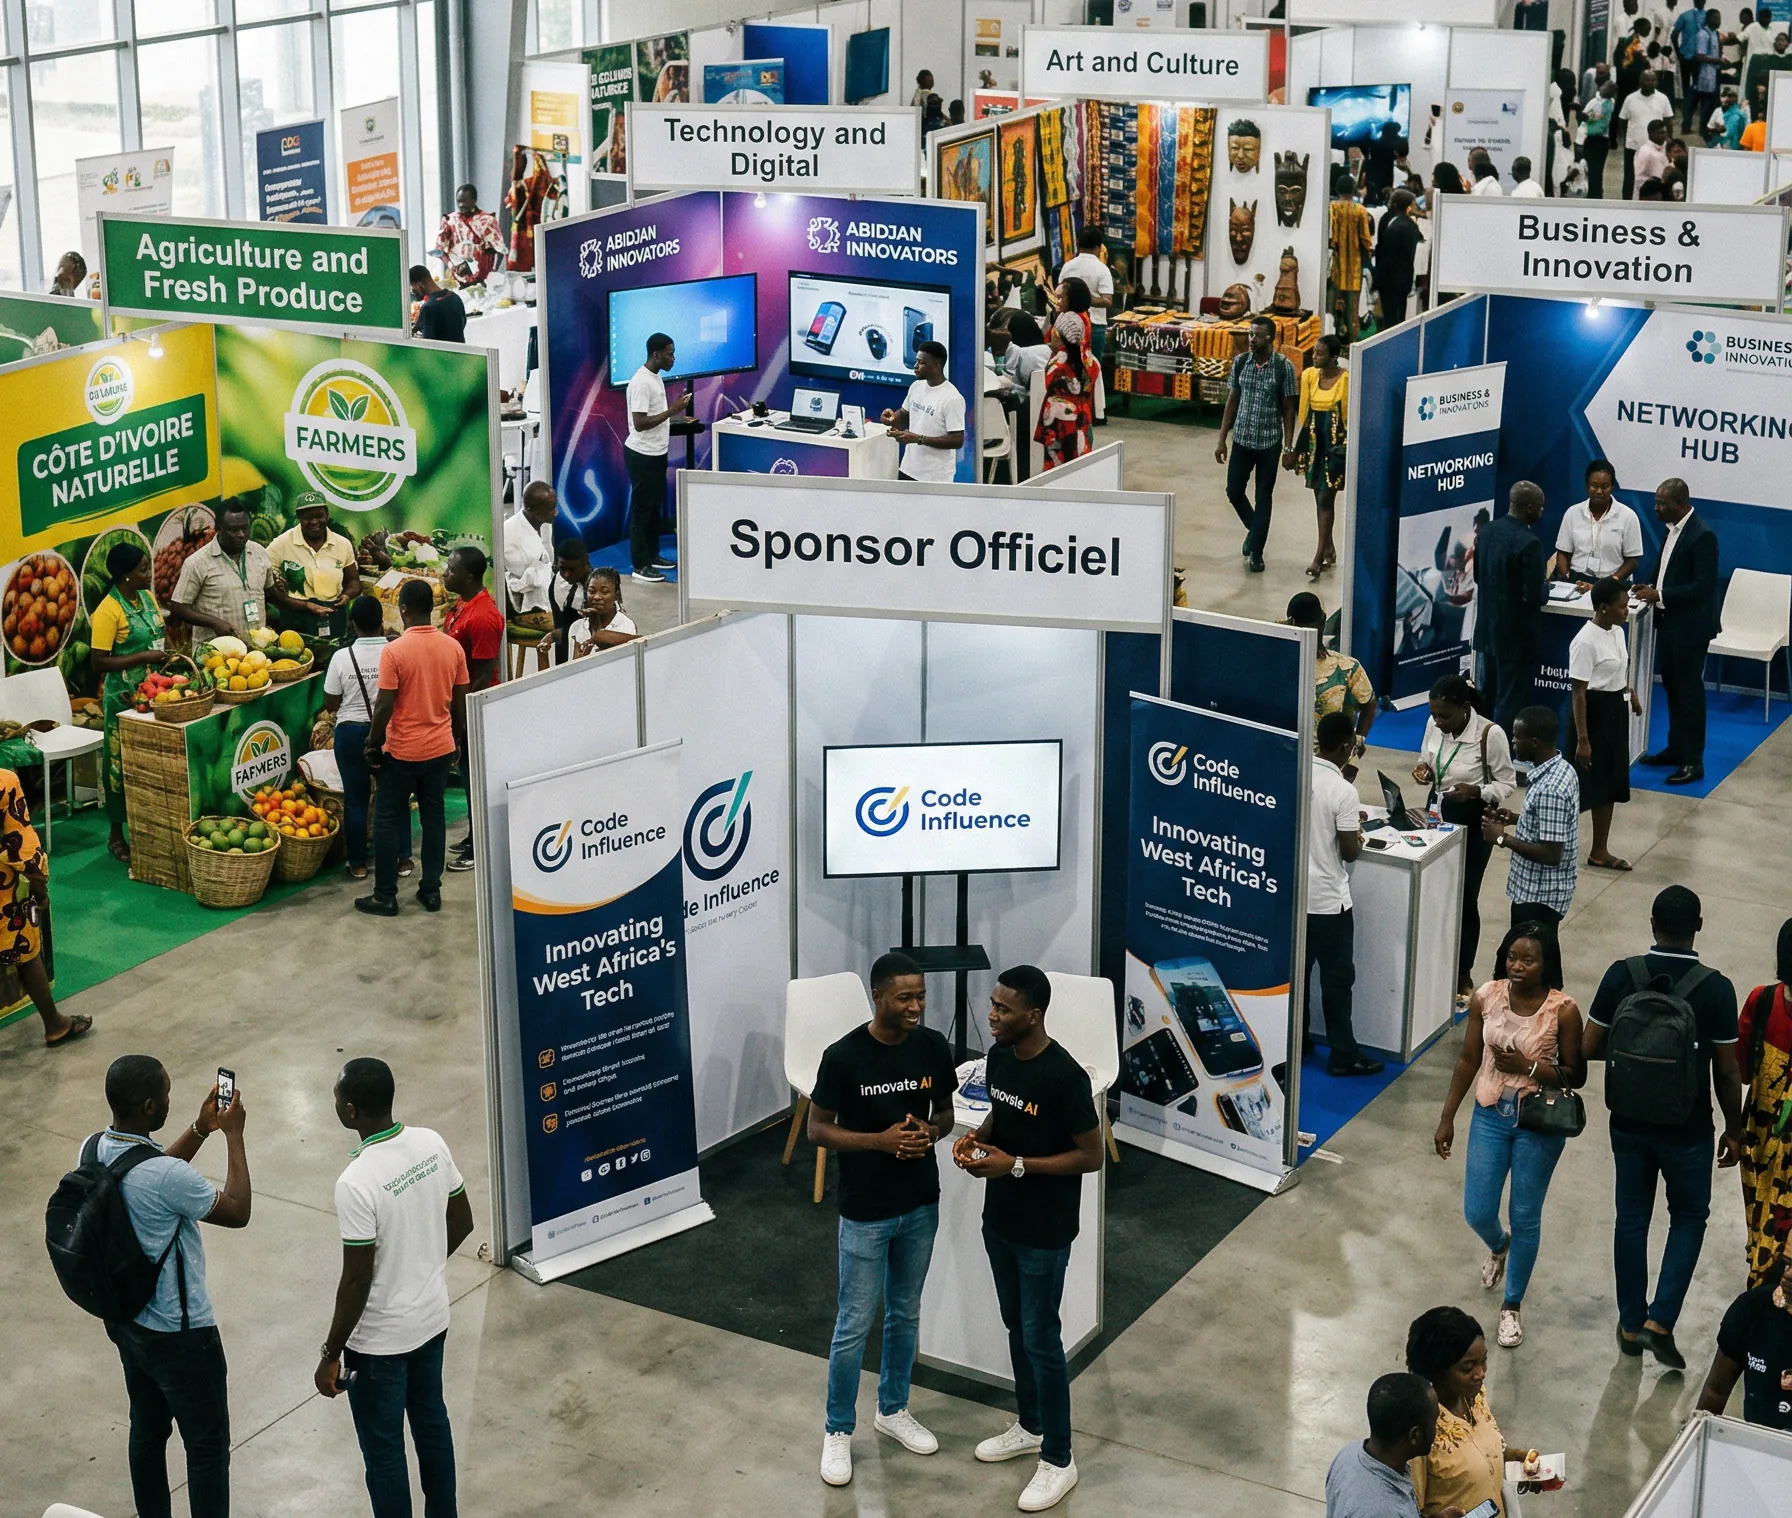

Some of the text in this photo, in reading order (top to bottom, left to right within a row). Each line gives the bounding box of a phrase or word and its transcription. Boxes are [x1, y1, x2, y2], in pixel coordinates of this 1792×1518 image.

[1046, 49, 1240, 77] Art and Culture
[663, 117, 886, 150] Technology and
[730, 151, 819, 182] Digital
[606, 224, 657, 252] ABIDJAN
[845, 221, 922, 243] ABIDJAN
[1518, 213, 1701, 248] Business &
[136, 233, 369, 275] Agriculture and
[607, 238, 681, 272] INNOVATORS
[846, 240, 958, 266] INNOVATORS
[1522, 251, 1693, 284] Innovation
[143, 270, 363, 313] Fresh Produce
[1439, 390, 1482, 405] BUSINESS
[1617, 400, 1792, 441] NETWORKIN
[32, 411, 194, 479] CÔTE D'IVOIRE
[296, 426, 406, 462] FARMERS
[1681, 437, 1740, 465] HUB
[52, 448, 180, 507] NATURELLE
[1408, 452, 1494, 480] NETWORKING
[1438, 474, 1465, 492] HUB
[730, 518, 1121, 577] Sponsor Officiel
[1193, 753, 1240, 779] Code
[921, 788, 983, 808] Code
[1193, 772, 1277, 809] Influence
[580, 812, 629, 838] Code
[921, 811, 1031, 831] Influence
[581, 824, 667, 860] Influence
[1152, 815, 1266, 867] Innovating
[1140, 838, 1278, 894] West Africa's
[703, 868, 780, 912] Influence
[1181, 876, 1232, 908] Tech
[545, 915, 664, 964] Innovating
[533, 939, 677, 996] West Africa's
[581, 980, 634, 1011] Tech
[860, 1076, 932, 1097] innovate AI
[1024, 1101, 1039, 1116] AI
